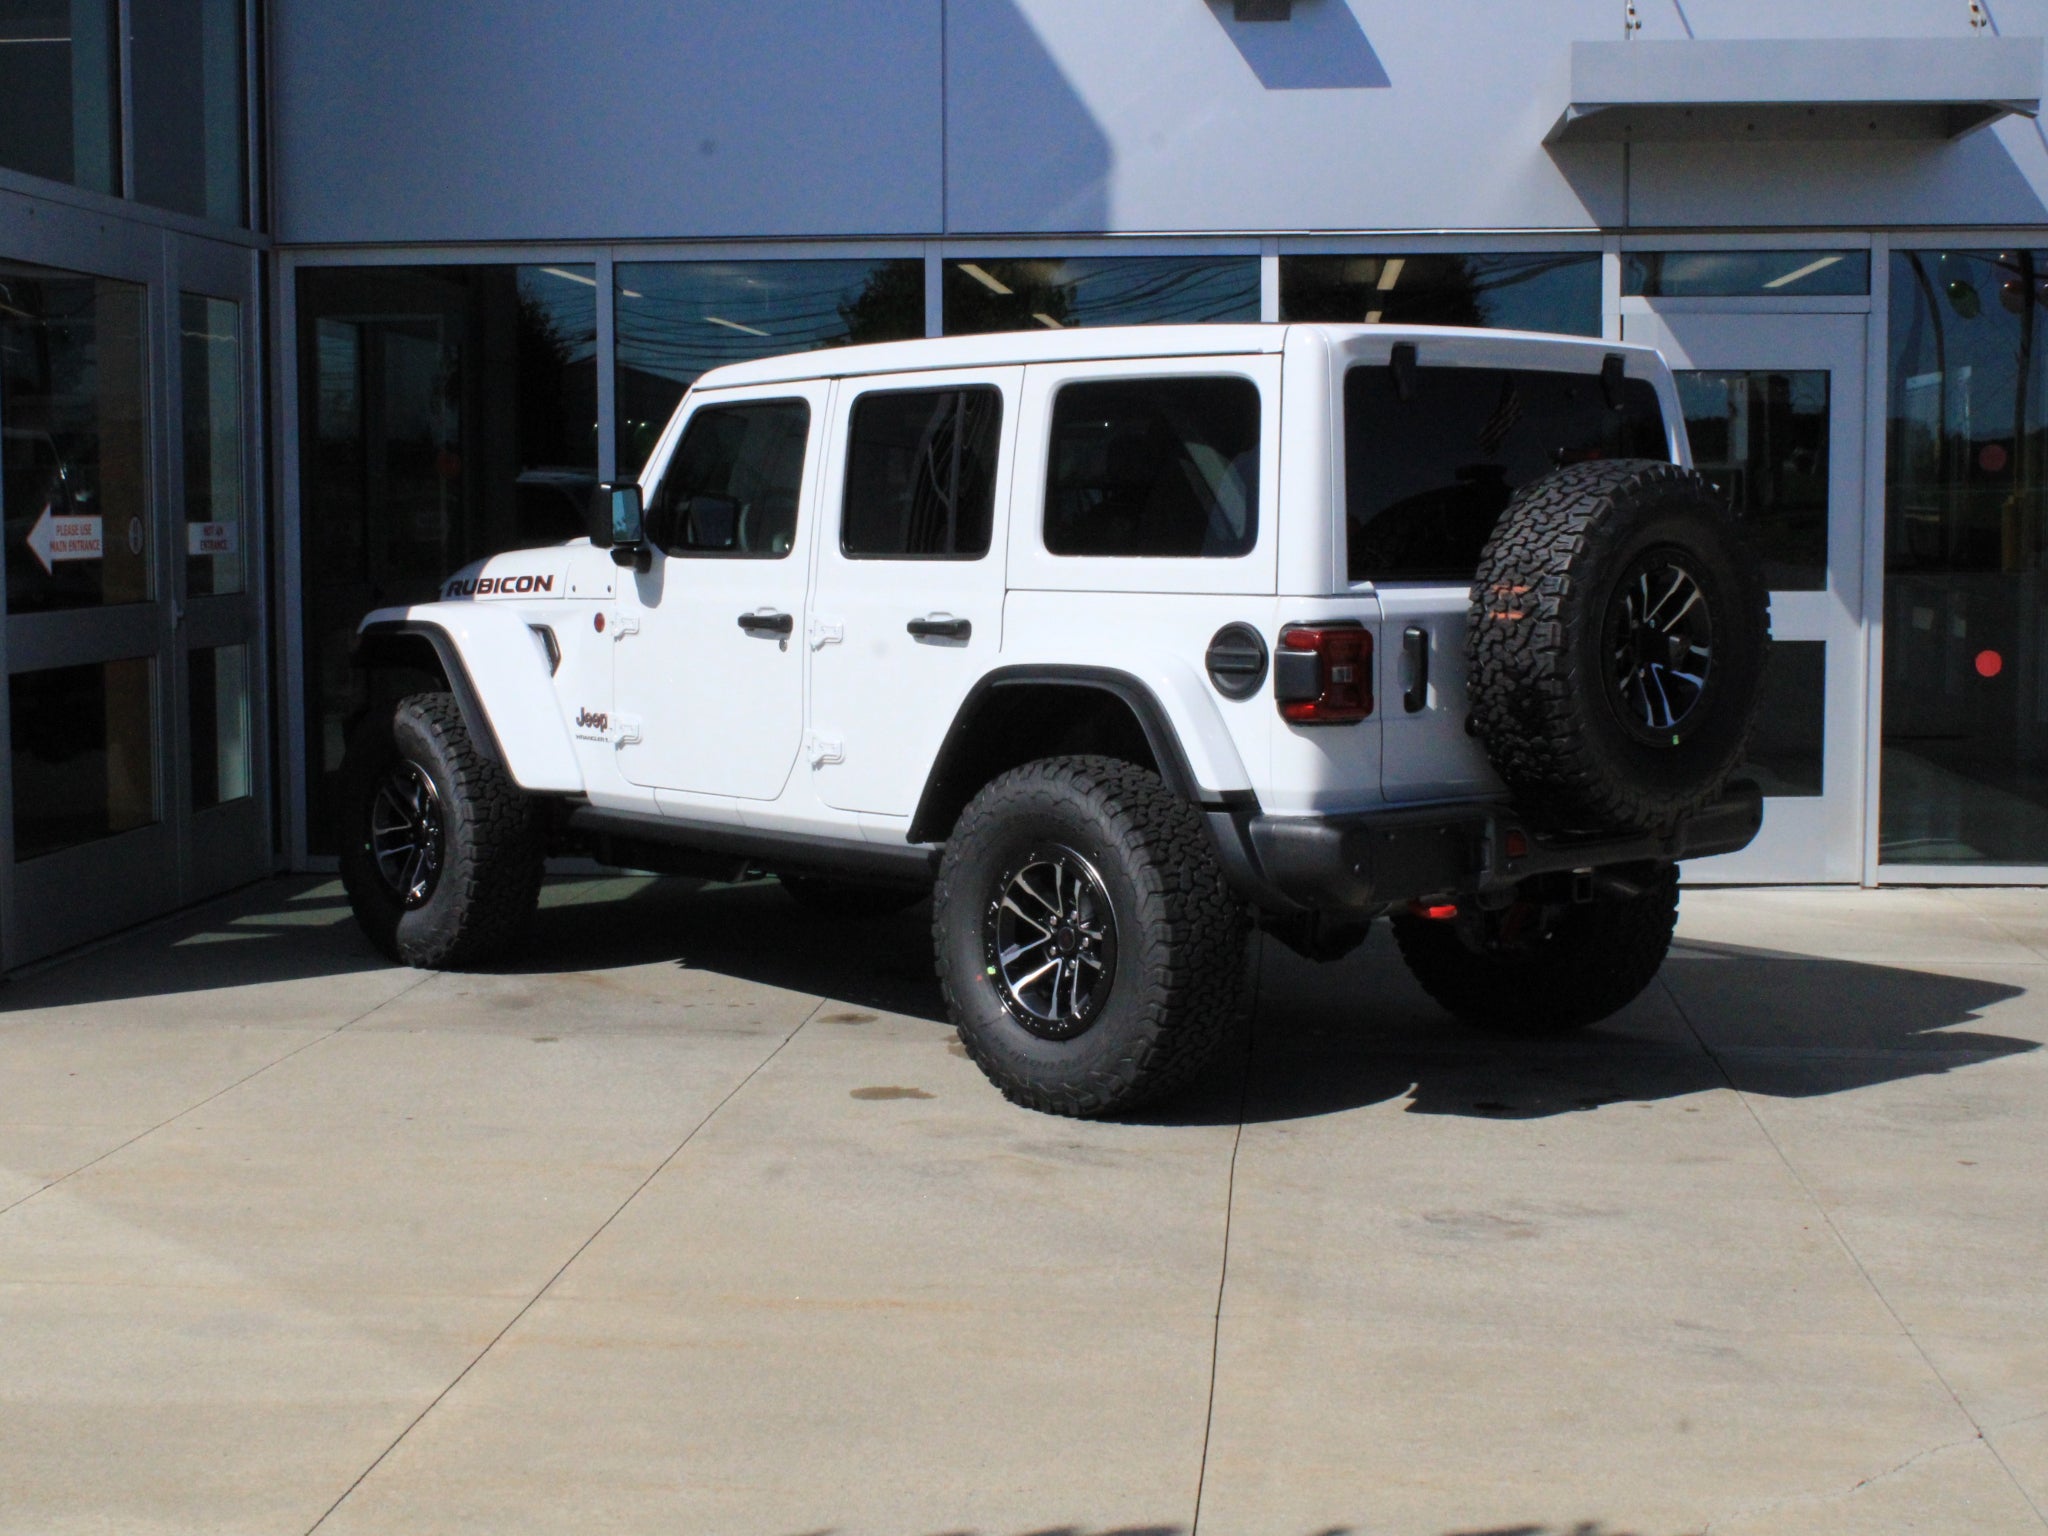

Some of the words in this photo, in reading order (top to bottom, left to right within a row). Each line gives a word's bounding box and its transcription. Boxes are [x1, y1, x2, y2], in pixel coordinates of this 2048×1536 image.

[56, 523, 80, 536] PLEASE
[80, 522, 92, 535] USE
[50, 539, 67, 552] MAIN
[68, 538, 100, 551] ENTRANCE
[446, 575, 554, 597] RUBICON
[575, 706, 608, 733] Jeep
